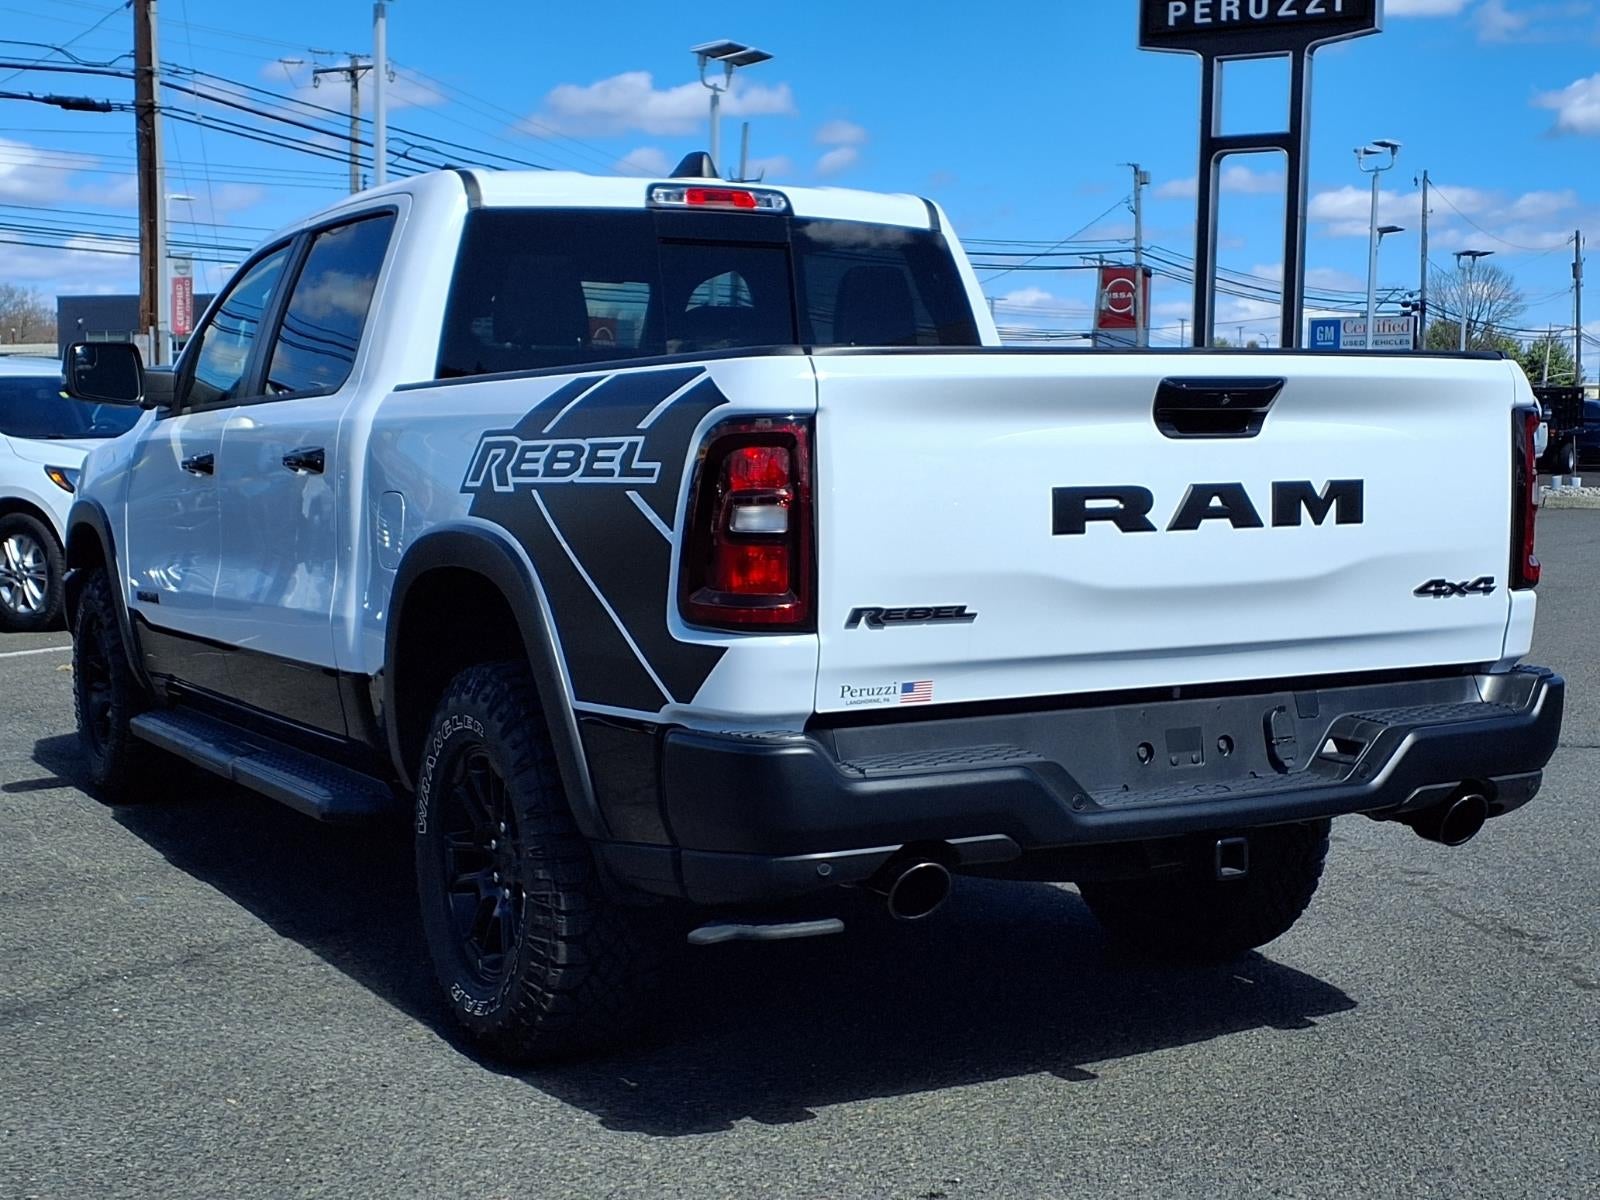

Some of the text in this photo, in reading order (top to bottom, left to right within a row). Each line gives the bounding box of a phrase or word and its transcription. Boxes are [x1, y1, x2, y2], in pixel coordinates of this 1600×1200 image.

[1316, 325, 1335, 342] GM
[1343, 319, 1410, 334] Cerified
[1342, 338, 1366, 347] USED
[464, 435, 662, 492] REBEL
[1052, 478, 1364, 536] RAM
[1412, 576, 1497, 599] 4x4
[844, 604, 978, 630] REBEL
[840, 681, 897, 699] Peruzzi
[417, 714, 485, 834] WRANGLER
